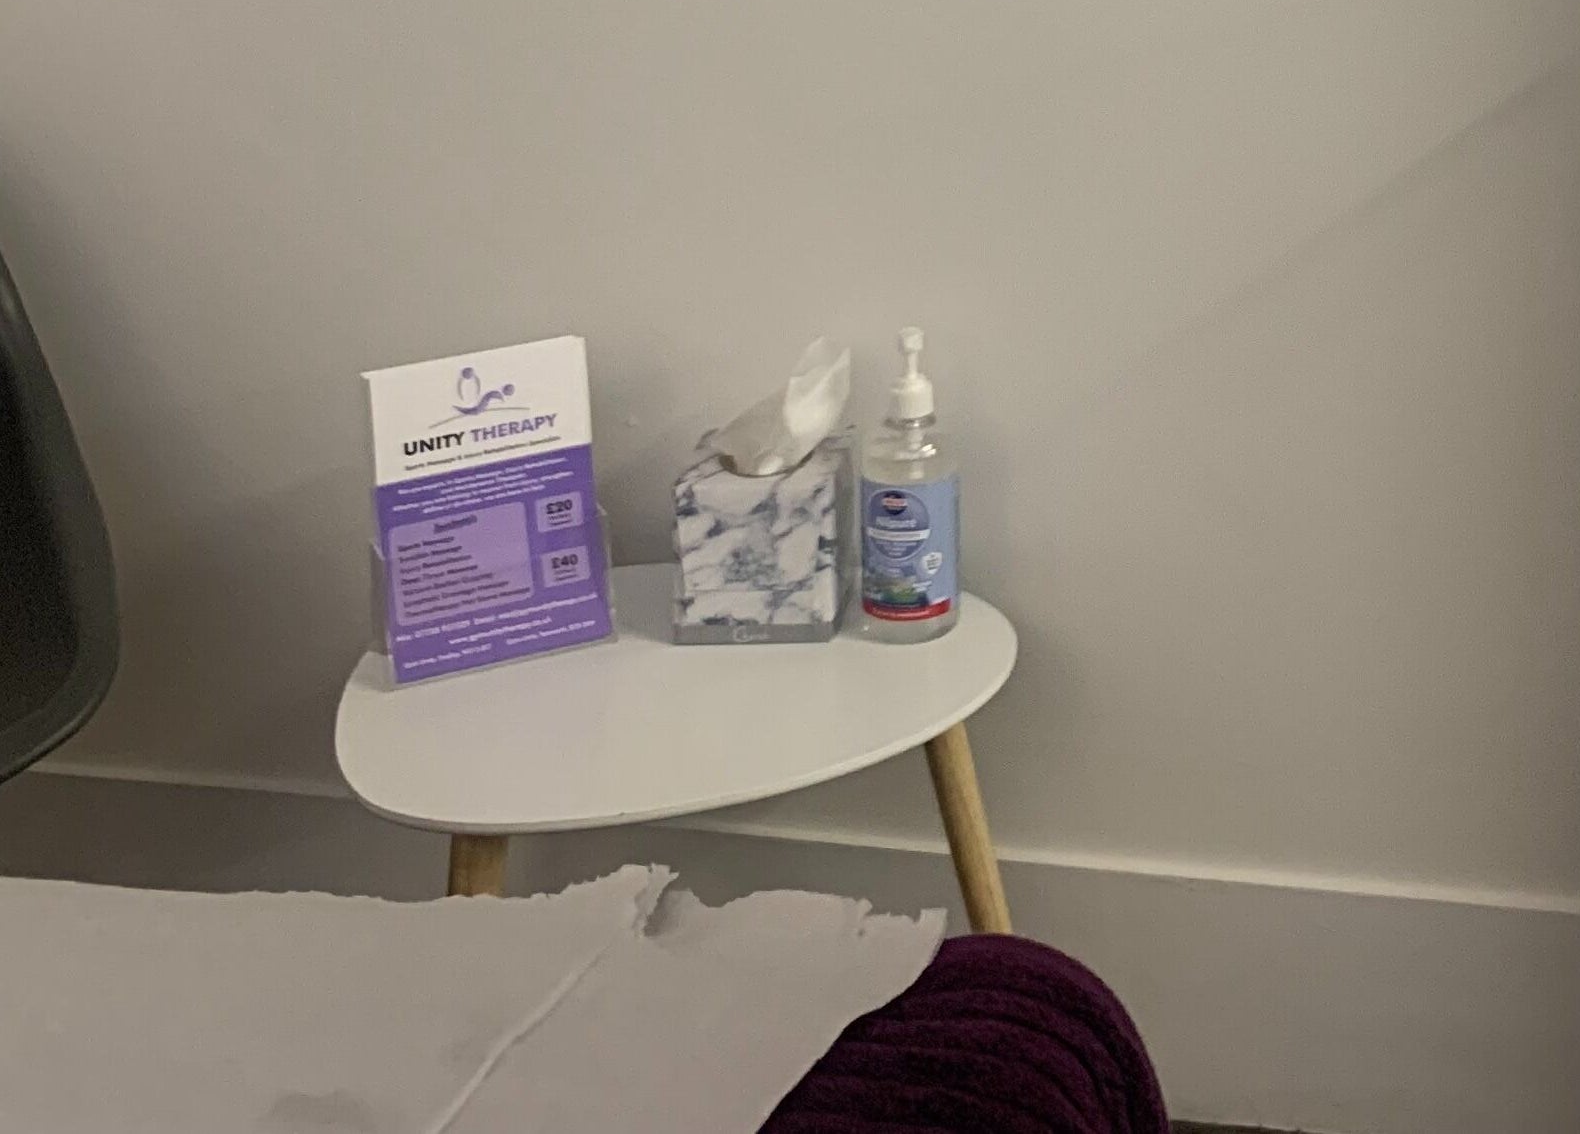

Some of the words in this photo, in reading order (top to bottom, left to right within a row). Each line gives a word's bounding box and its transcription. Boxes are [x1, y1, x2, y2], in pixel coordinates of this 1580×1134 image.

[403, 431, 465, 456] UNITY
[470, 413, 558, 443] THERAPY
[546, 499, 573, 515] £20
[551, 553, 579, 569] £40
